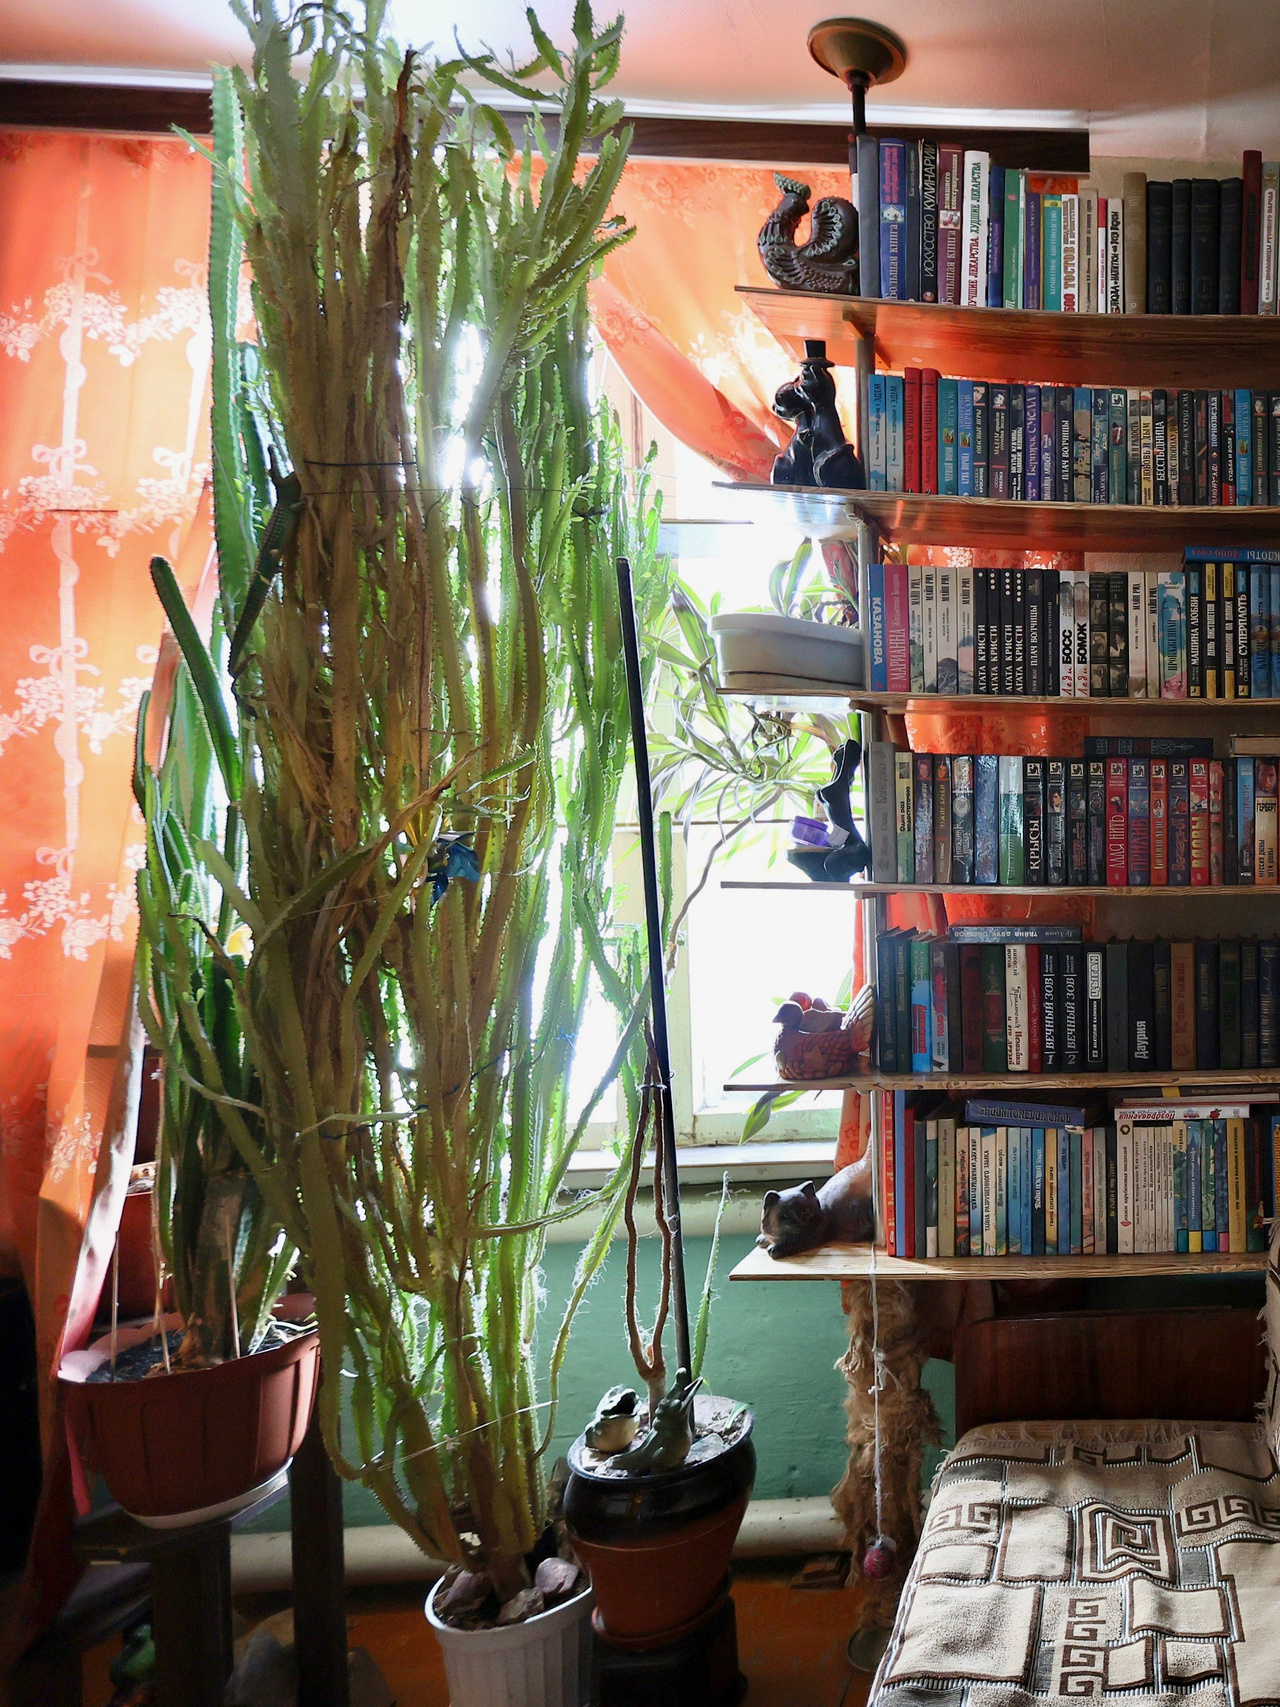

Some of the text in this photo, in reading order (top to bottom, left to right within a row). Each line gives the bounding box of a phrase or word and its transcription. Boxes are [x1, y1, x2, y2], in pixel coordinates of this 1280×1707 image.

[924, 144, 935, 277] ИСКУССТВО КУЛИНАРИИ
[969, 162, 981, 277] ЛЕКАРСТВА ХУДШИЕ ЛЕКАРСТВА
[886, 224, 898, 300] Большая книга
[942, 230, 956, 304] Большая книга
[1064, 247, 1075, 312] 500 ТОСТОВ
[924, 396, 932, 442] МАРИНИНА
[1026, 397, 1038, 476] Бертрис СМОЛЛ
[1062, 420, 1070, 457] ВОЛЧИЦЫ
[1155, 421, 1165, 480] БЕССТЫДНИЦА
[1215, 549, 1238, 558] 2000
[910, 591, 920, 605] МАЙН
[911, 578, 921, 588] РИД
[924, 574, 934, 601] МАЙН РИД
[940, 574, 950, 602] МАЙН РИД
[960, 590, 971, 605] МАЙН
[961, 578, 970, 588] РИД
[1131, 583, 1142, 610] МАЙН РИД
[1030, 604, 1038, 643] ВОЛЧИЦЫ
[1148, 599, 1157, 614] МАЙН
[1190, 596, 1198, 626] ЛЮБВИ
[1238, 594, 1248, 655] СУПЕРПЛОТЬ
[873, 597, 883, 665] КАЗАНОВА
[978, 624, 986, 661] КРИСТИ
[1167, 620, 1178, 670] ПРОКАЖЕННАЯ
[1207, 641, 1216, 656] ДЕНЬ
[889, 628, 906, 680] МАРИАННА
[1062, 629, 1072, 696] Леди БОСС
[1077, 623, 1088, 696] Леди БОМЖ
[1256, 802, 1276, 812] ГЕРБЕРТ
[1029, 820, 1041, 870] КРЫСЫ
[1109, 815, 1125, 868] АЛАЯ НИТЬ
[1130, 820, 1147, 871] ПРИЛИВ
[1191, 817, 1206, 867] ВДОВЫ
[1090, 956, 1101, 997] ЦЫГАН
[1043, 977, 1055, 1049] ВЕЧНЫЙ ЗОВ
[1064, 977, 1076, 1049] ВЕЧНЫЙ ЗОВ
[1047, 1055, 1054, 1064] 1
[1069, 1055, 1076, 1064] 2
[1134, 1020, 1148, 1059] Даурия
[979, 1106, 1071, 1123] ЭНЦИКЛОПЕДИЯ СНОВ
